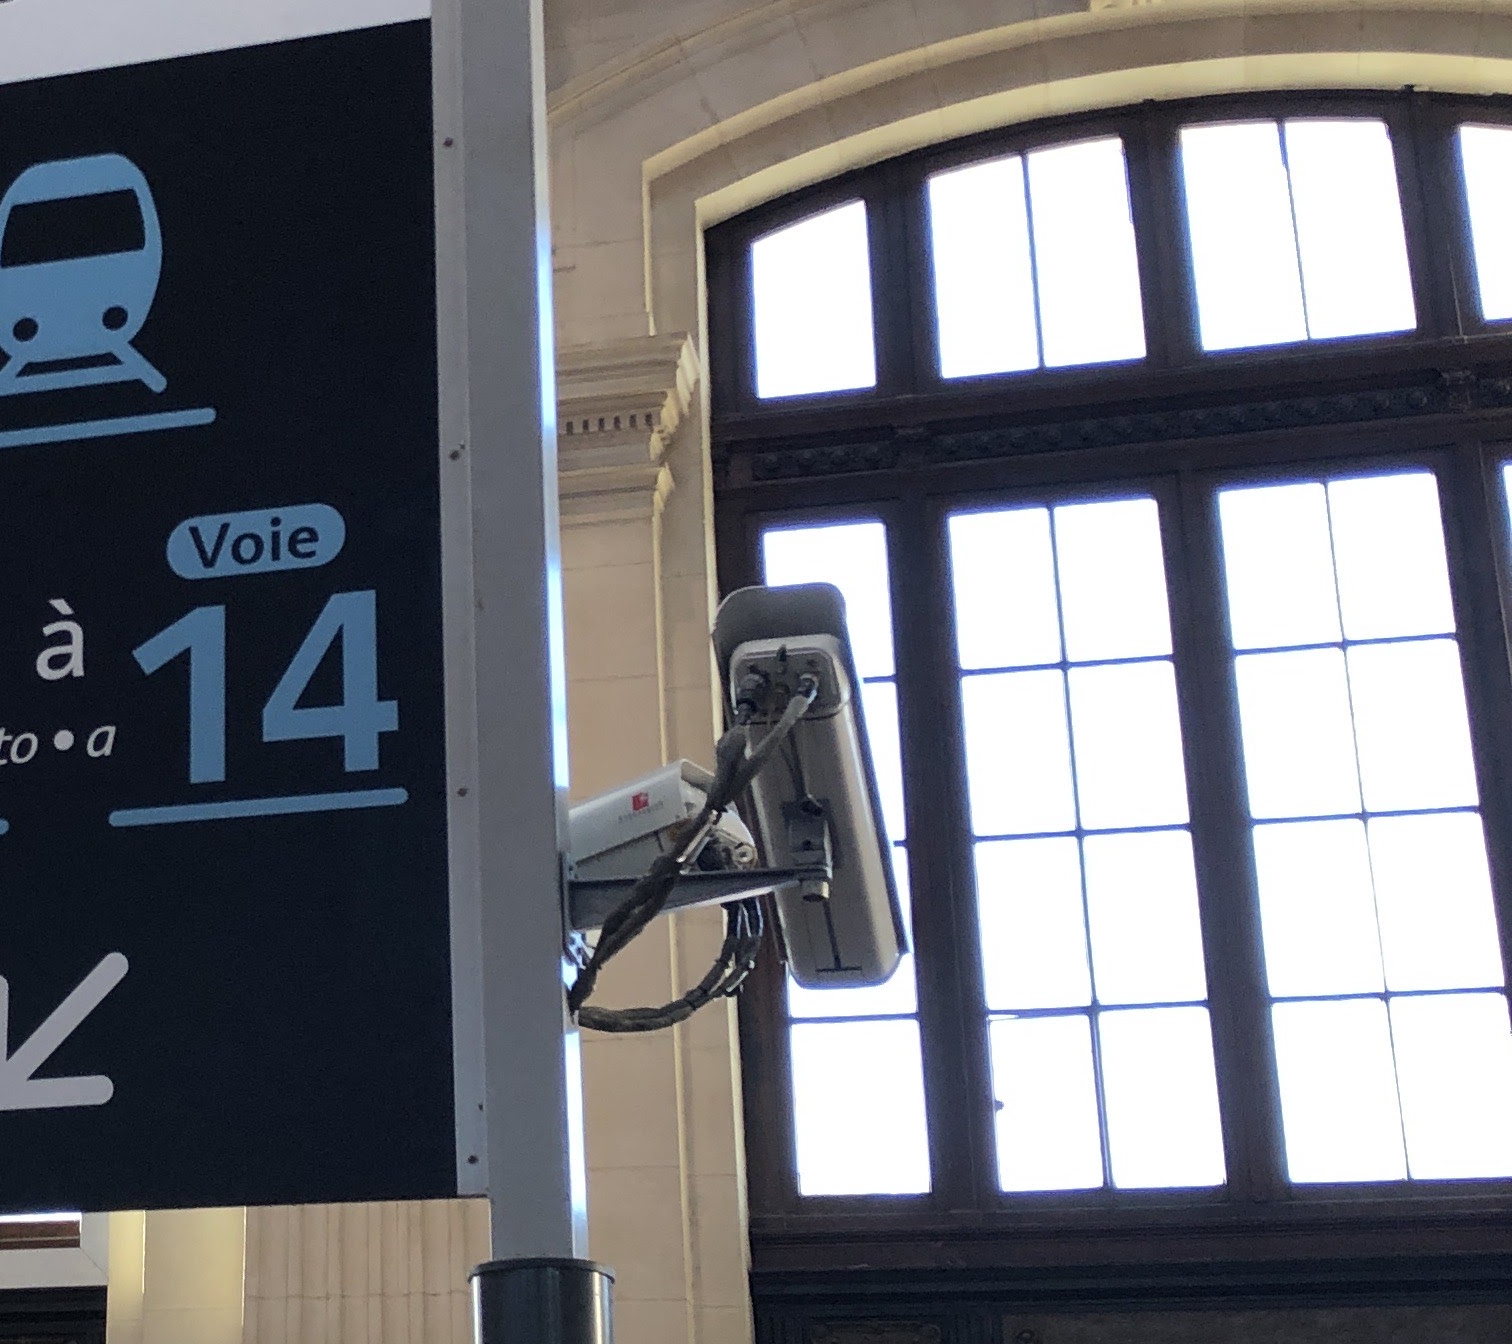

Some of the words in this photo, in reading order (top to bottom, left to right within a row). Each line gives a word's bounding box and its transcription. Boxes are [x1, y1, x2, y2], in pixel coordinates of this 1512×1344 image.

[188, 515, 321, 570] Voie
[35, 598, 86, 681] à
[132, 589, 399, 784] 14
[87, 723, 116, 759] a
